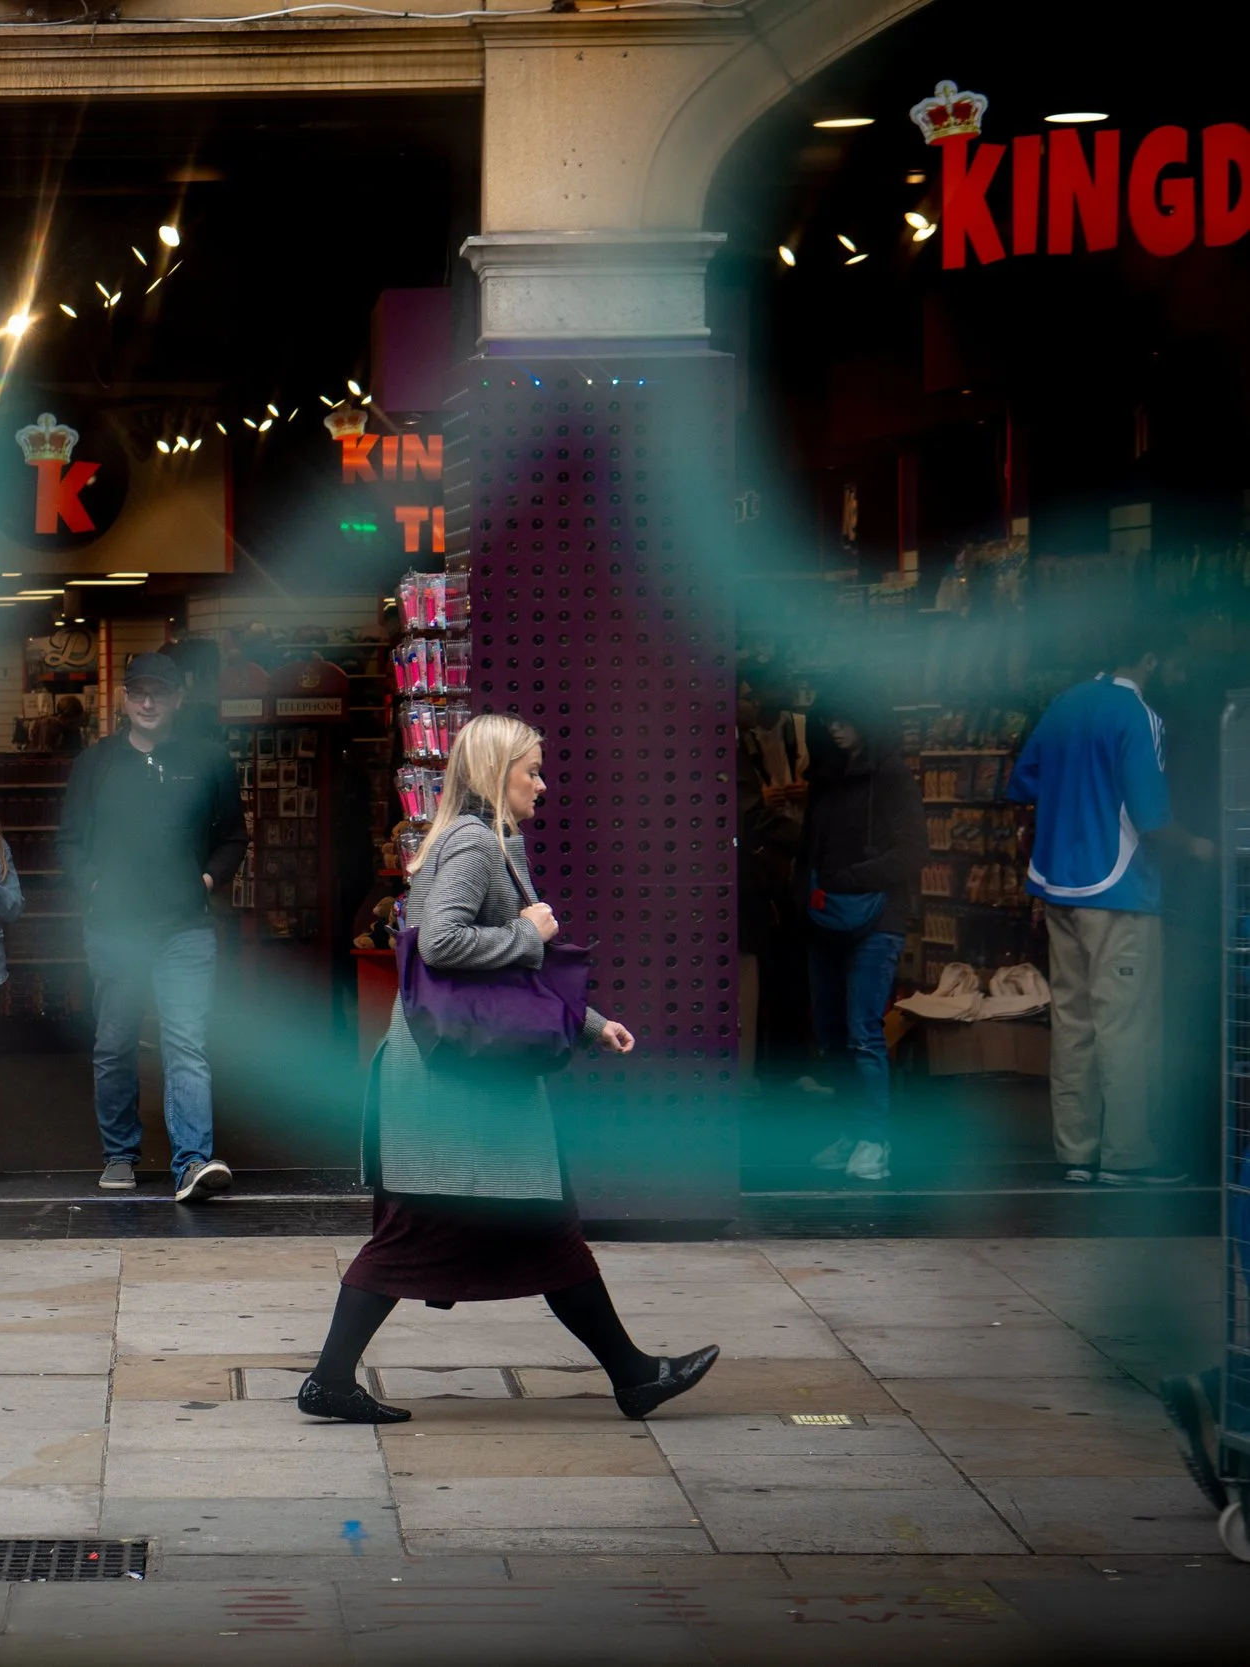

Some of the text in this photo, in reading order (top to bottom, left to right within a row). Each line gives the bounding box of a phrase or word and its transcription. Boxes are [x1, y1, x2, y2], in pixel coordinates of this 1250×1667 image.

[930, 122, 1250, 270] KINGD
[336, 433, 443, 484] KIN
[30, 459, 102, 534] K
[279, 701, 341, 712] TELEPHONE
